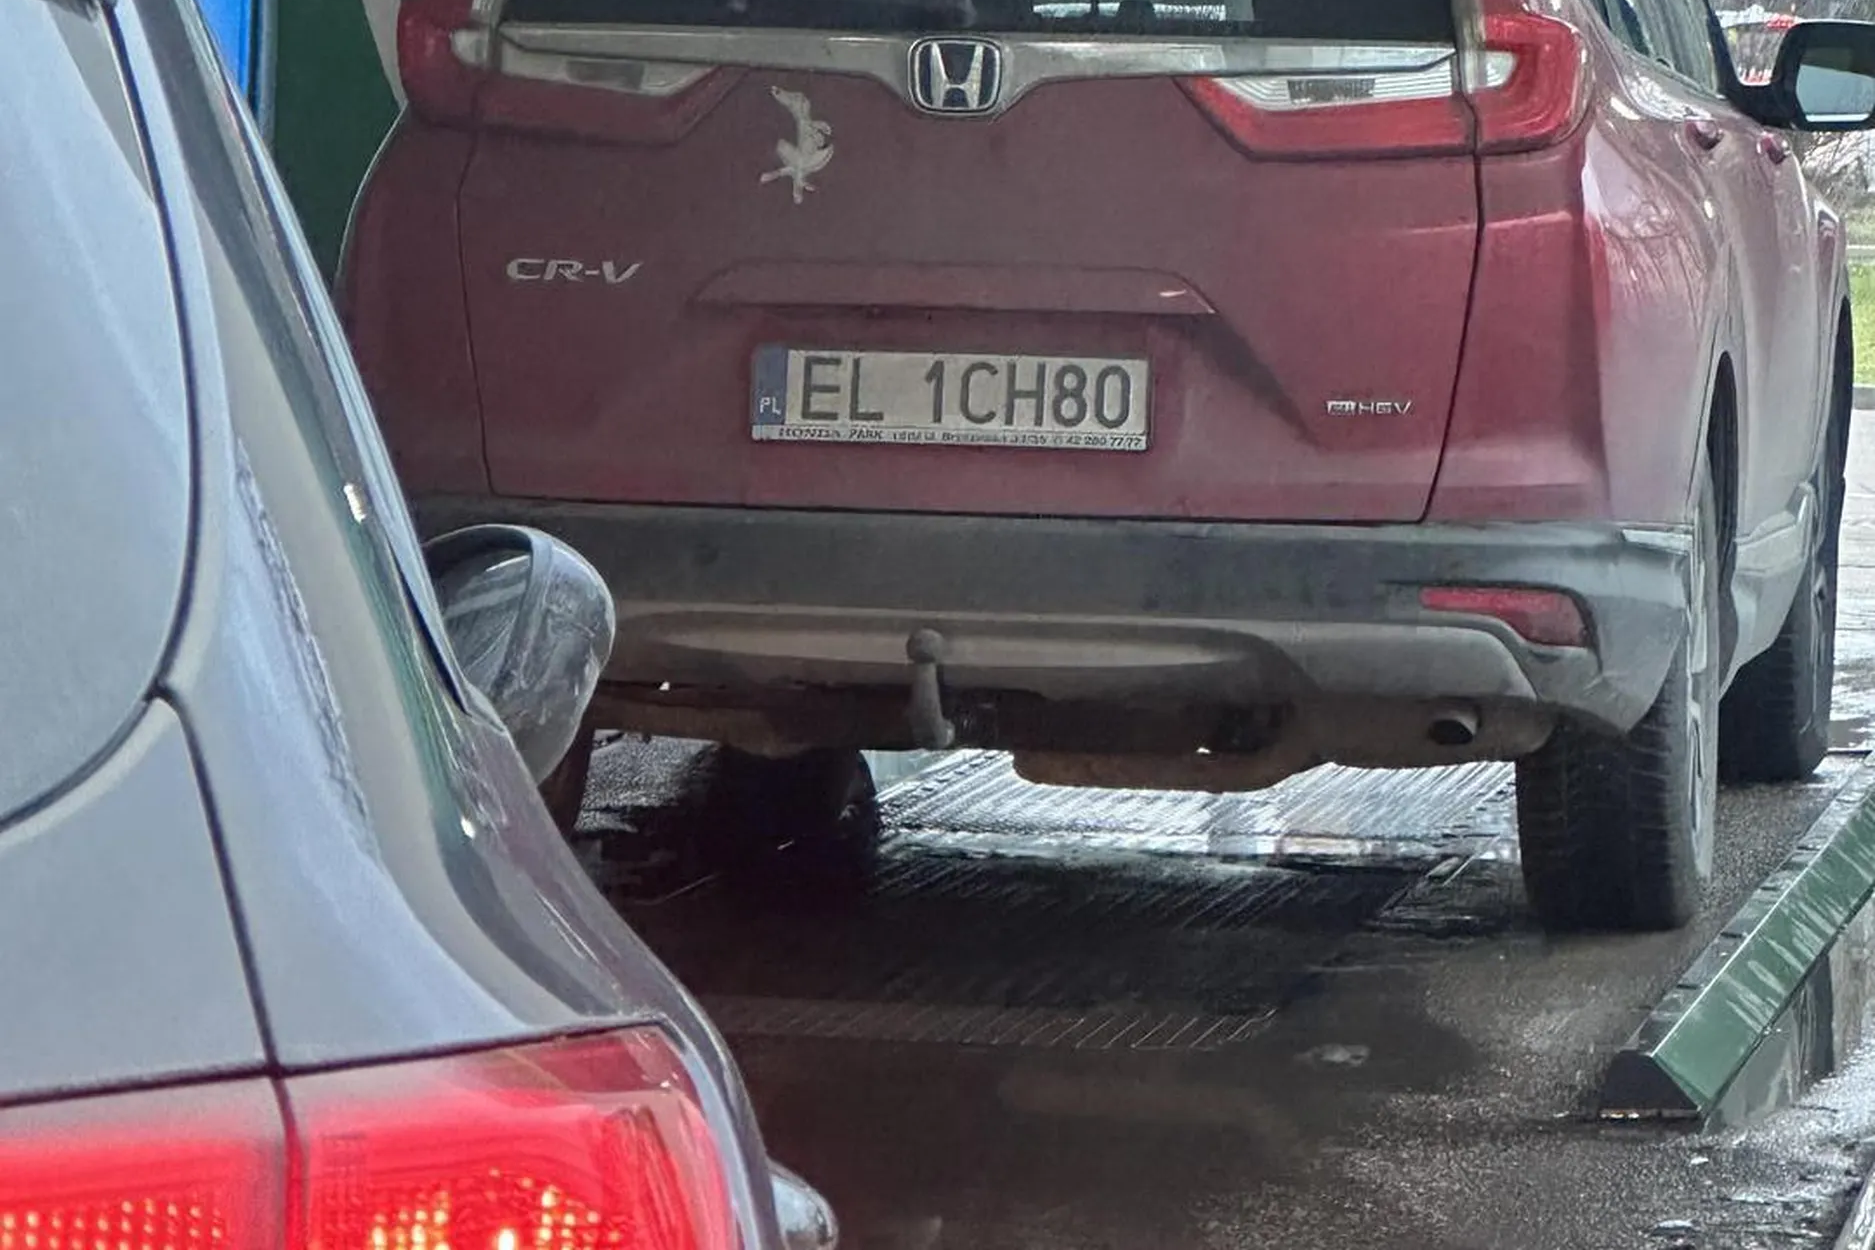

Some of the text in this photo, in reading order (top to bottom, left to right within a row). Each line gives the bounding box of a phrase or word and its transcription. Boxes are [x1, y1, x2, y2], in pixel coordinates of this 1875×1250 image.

[506, 258, 643, 284] CR-V
[802, 355, 1132, 429] EL 1CH80
[759, 396, 781, 415] PL
[849, 428, 884, 440] PARK
